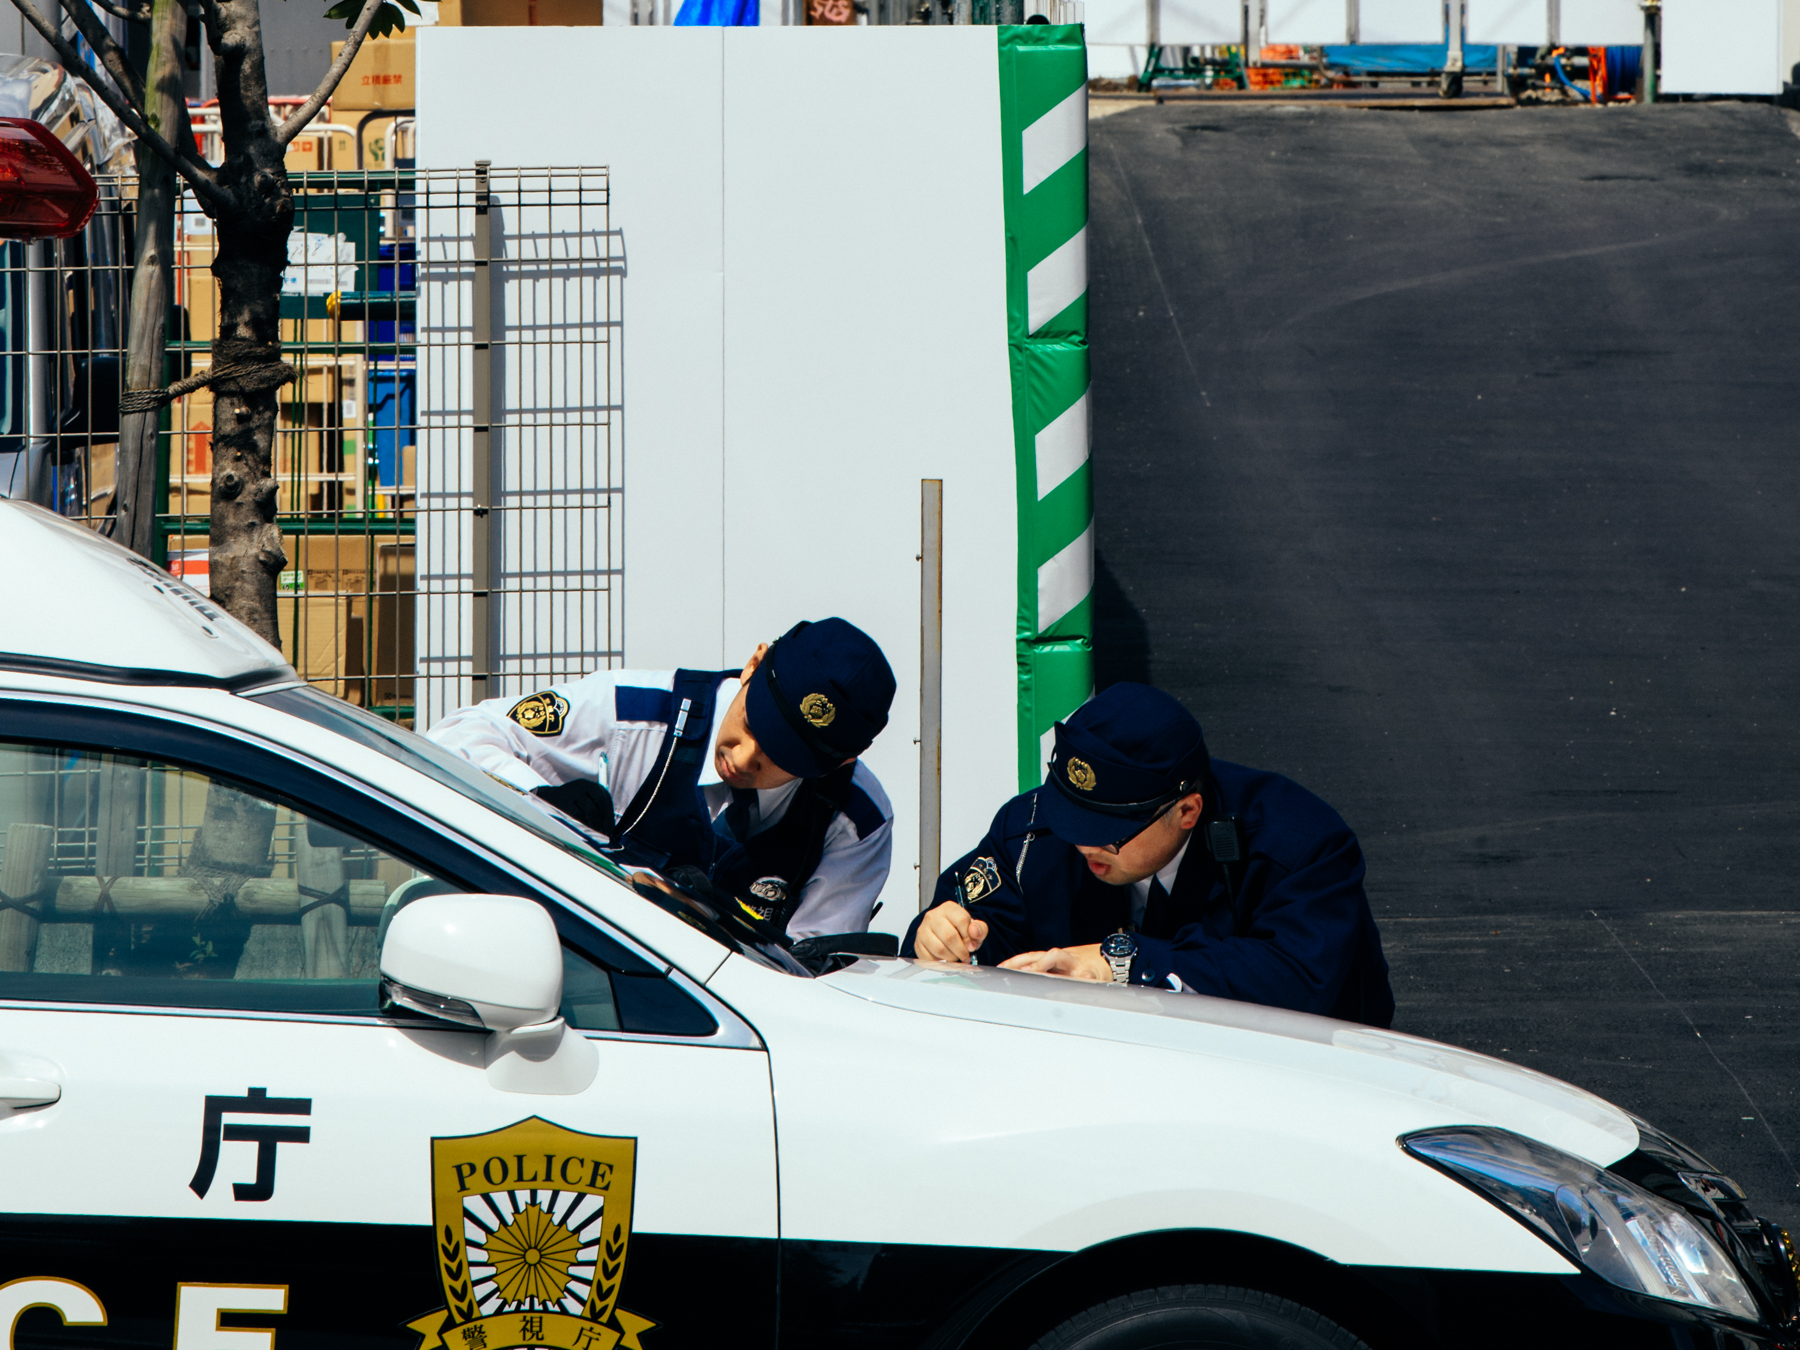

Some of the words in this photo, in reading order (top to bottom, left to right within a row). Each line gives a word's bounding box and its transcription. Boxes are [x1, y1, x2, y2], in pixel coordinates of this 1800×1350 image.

[189, 1087, 312, 1202] 庁
[452, 1154, 614, 1193] POLICE
[461, 1315, 602, 1350] 警視庁
